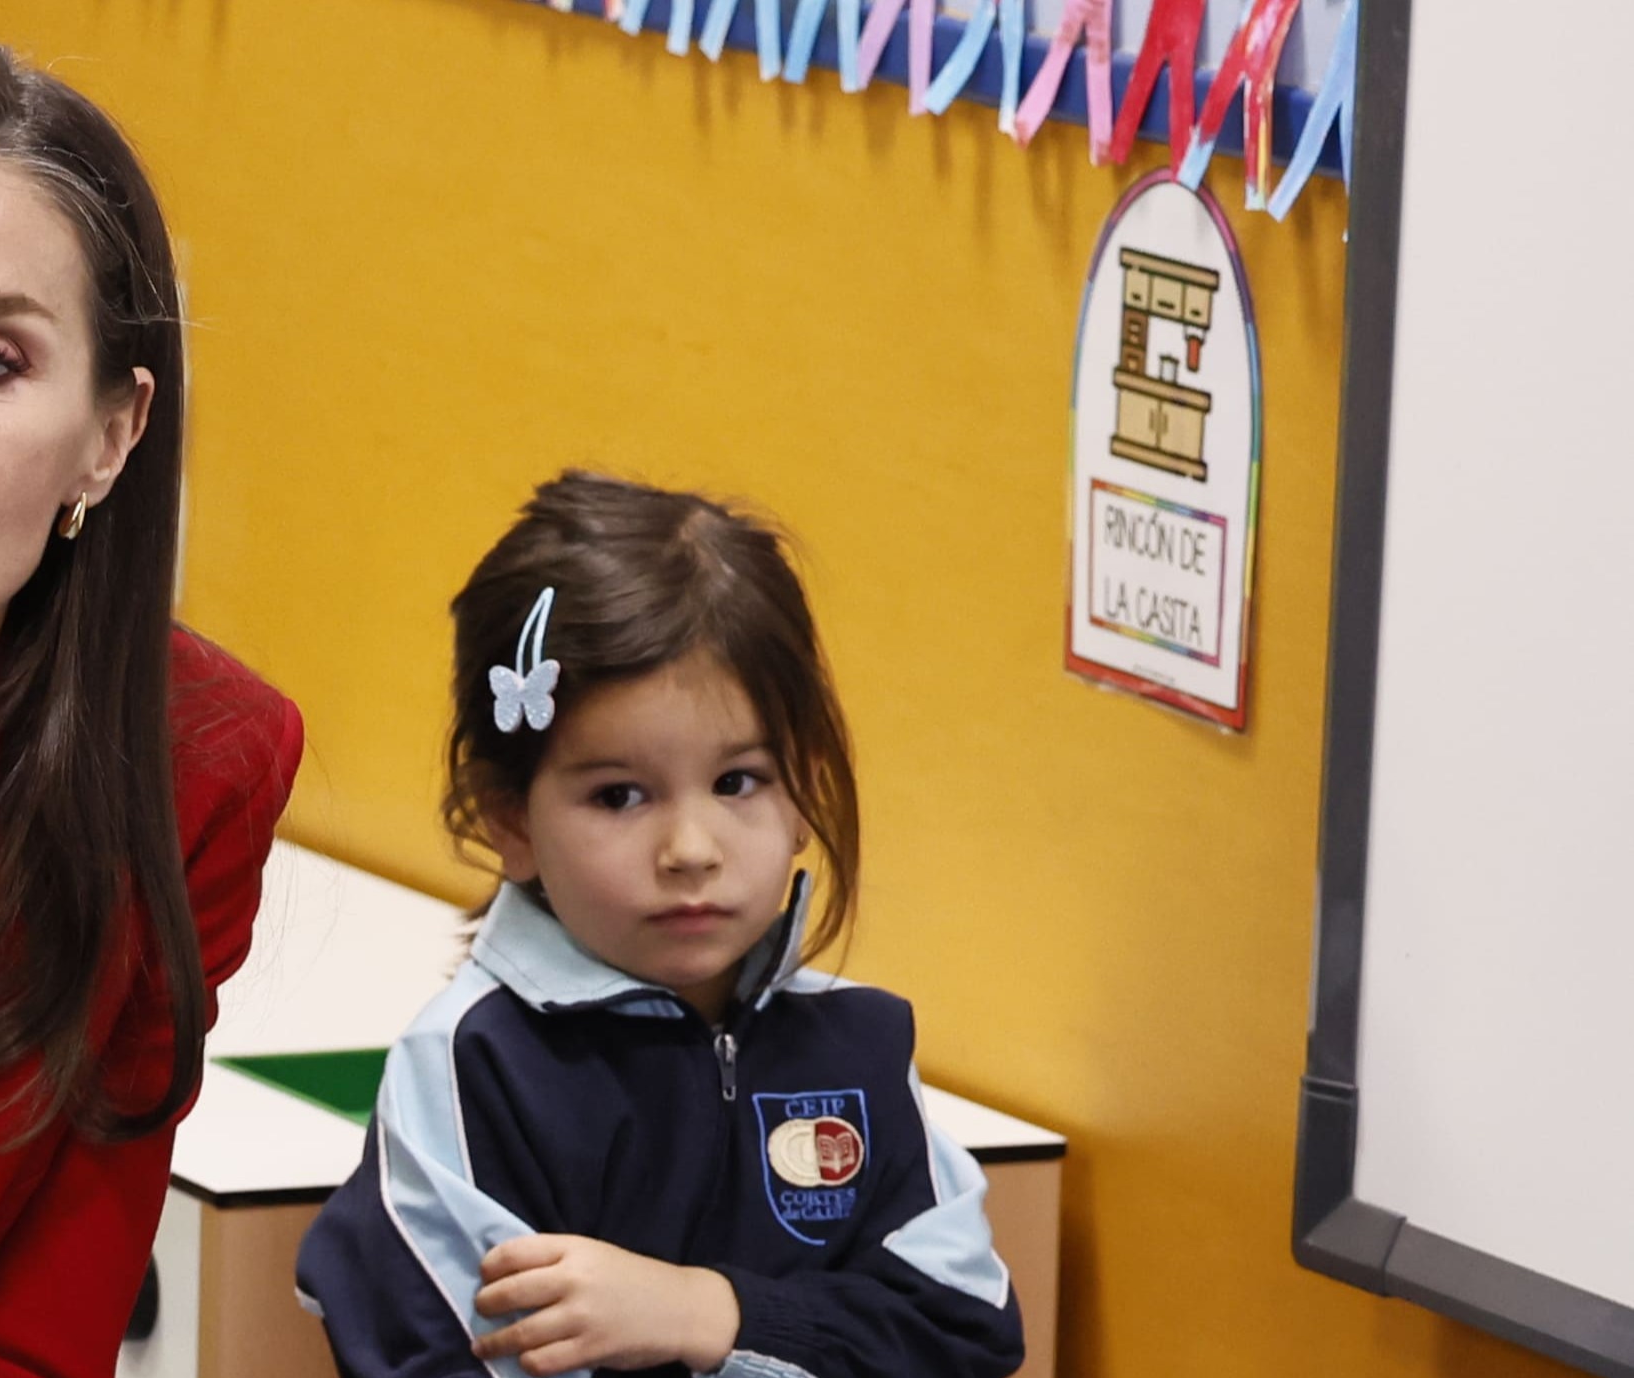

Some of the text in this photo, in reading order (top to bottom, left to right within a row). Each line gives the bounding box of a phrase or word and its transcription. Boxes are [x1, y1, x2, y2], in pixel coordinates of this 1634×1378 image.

[1104, 505, 1207, 576] RINCÓN DE
[1103, 574, 1202, 647] LA CASITA
[784, 1097, 845, 1118] CEIP
